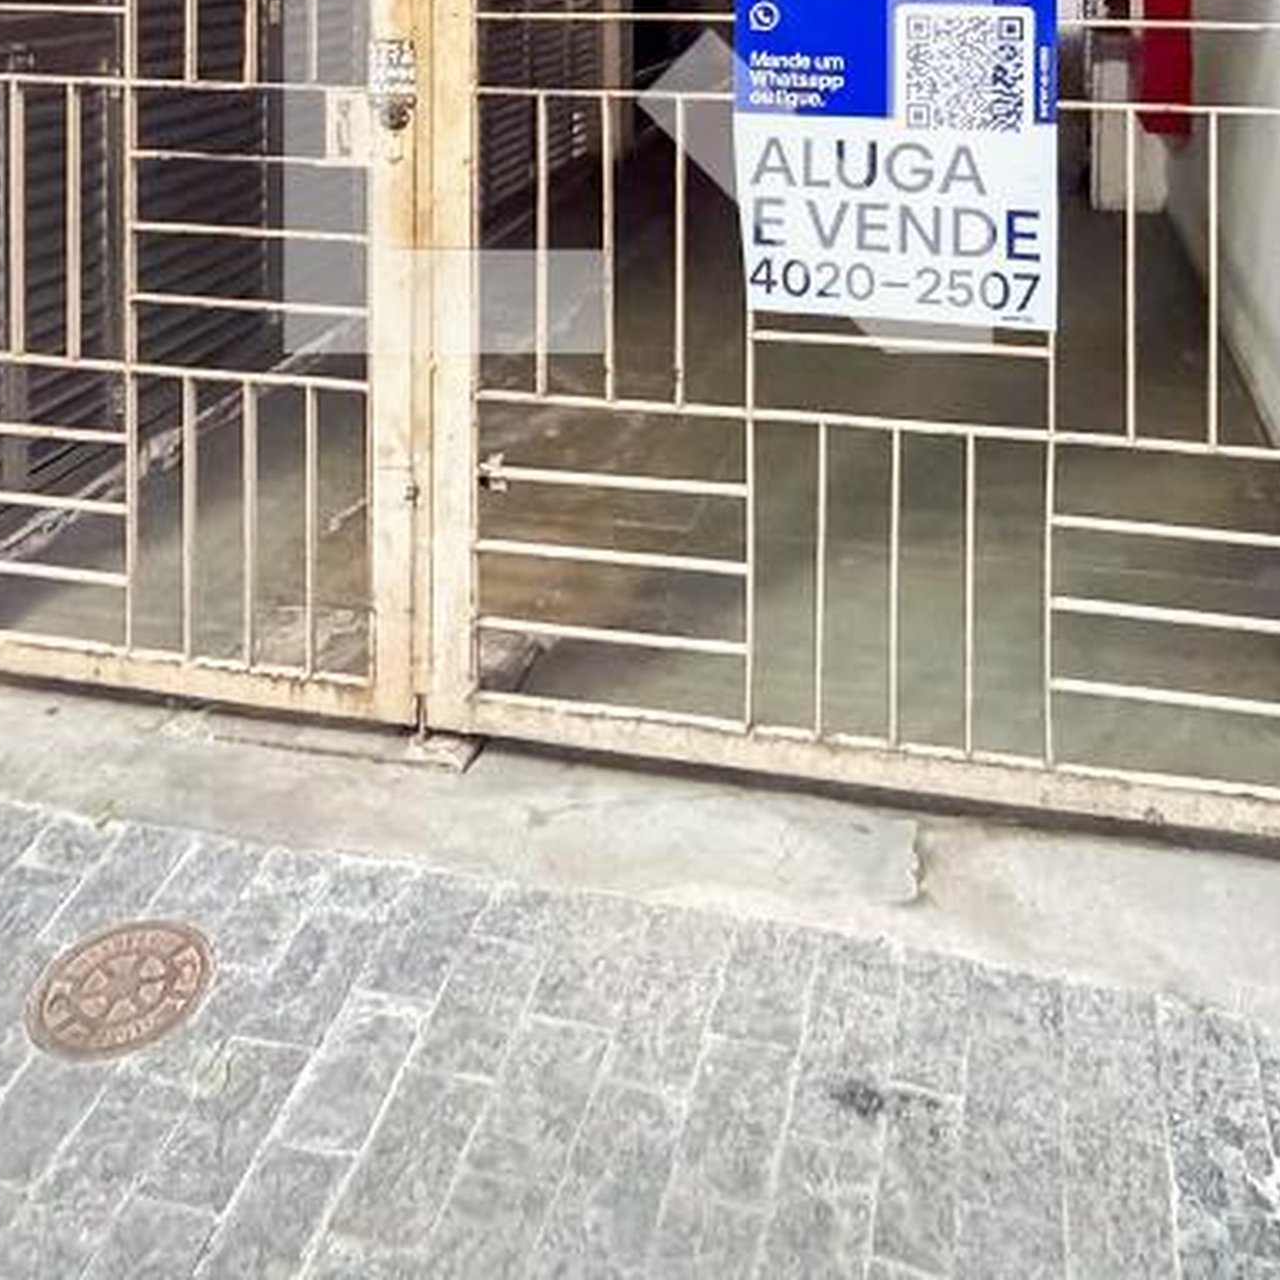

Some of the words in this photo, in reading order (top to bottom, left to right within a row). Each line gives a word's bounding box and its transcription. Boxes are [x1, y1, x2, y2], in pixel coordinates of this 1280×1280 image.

[749, 50, 811, 69] Mande
[814, 55, 845, 71] um
[751, 136, 988, 196] ALUGA
[753, 197, 786, 247] E
[806, 200, 1041, 263] VENDE
[749, 258, 1042, 312] 4020-2507
